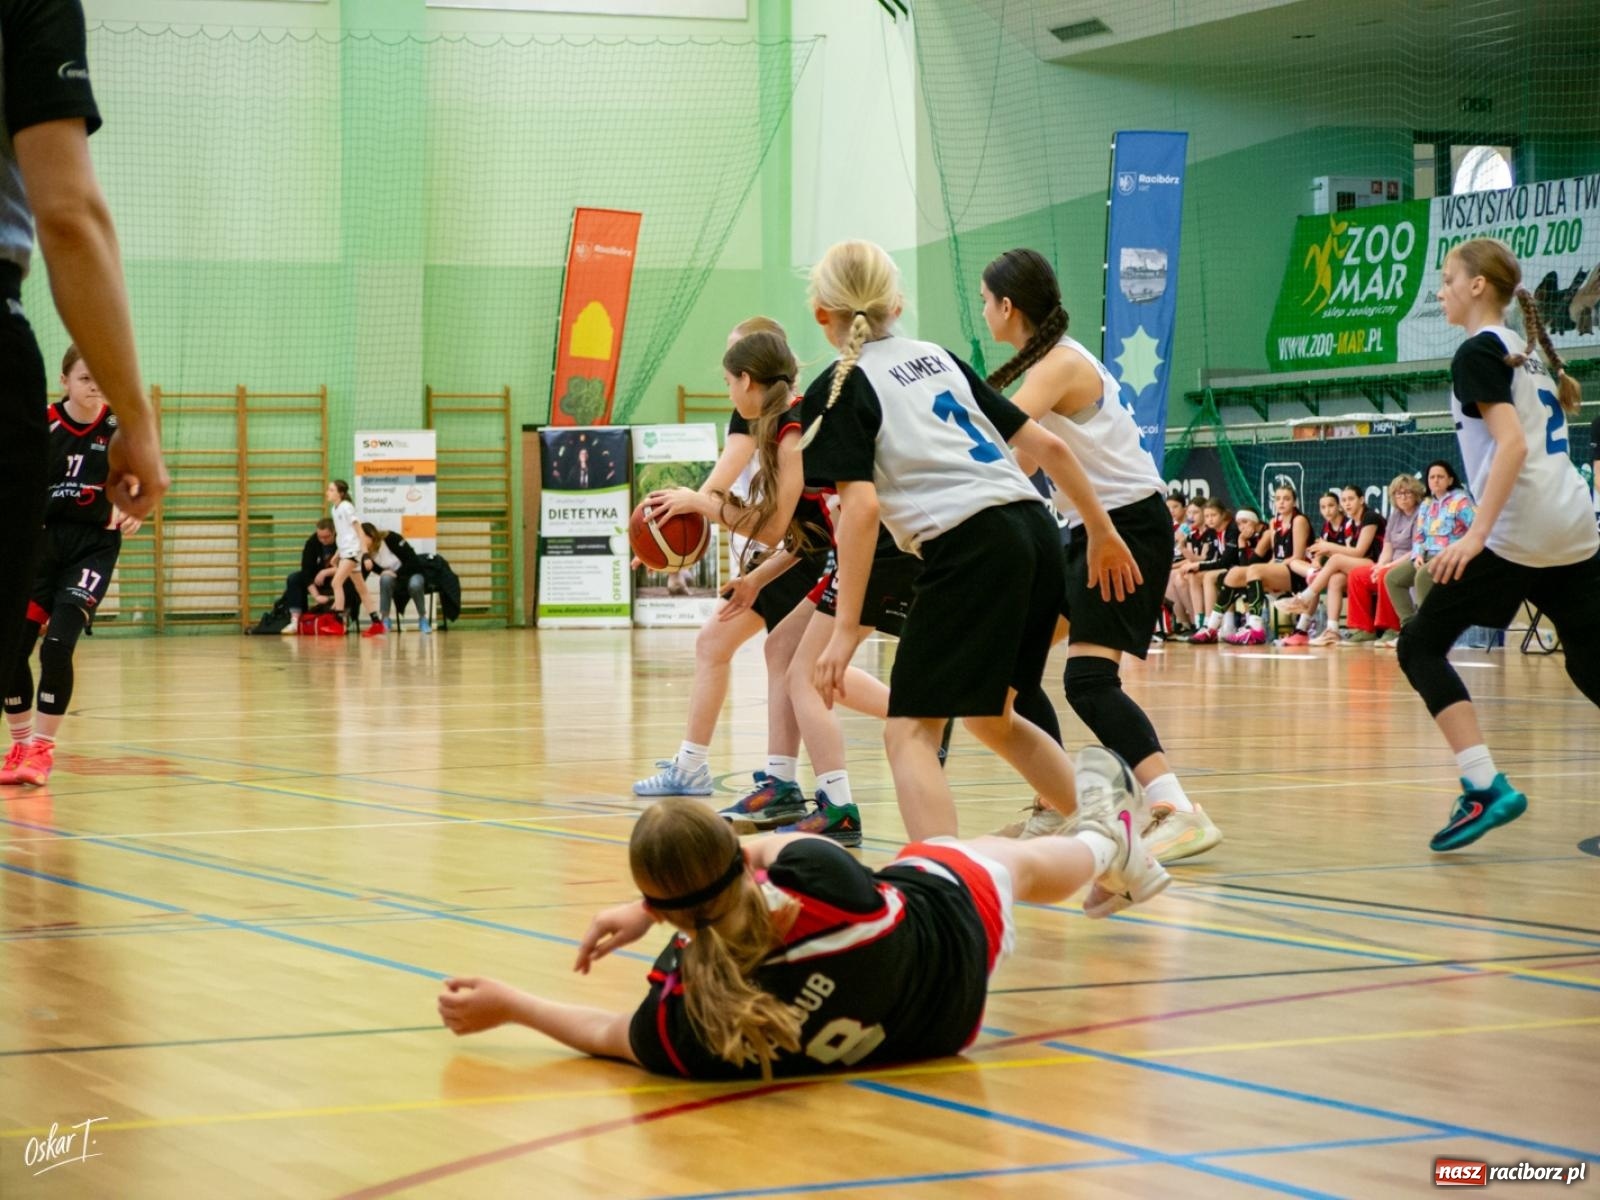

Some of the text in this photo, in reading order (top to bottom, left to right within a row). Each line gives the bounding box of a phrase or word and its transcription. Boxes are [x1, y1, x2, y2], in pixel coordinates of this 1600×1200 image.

[1138, 173, 1180, 185] Racibórz
[1440, 185, 1529, 232] WSZYSTKO
[1534, 181, 1567, 217] DLA
[1343, 221, 1416, 266] ZOO
[1543, 217, 1583, 256] ZOO
[1328, 262, 1408, 305] MAR
[1278, 327, 1384, 361] WWW.ZOO-MAR.PL
[888, 355, 952, 387] KLIMEK
[932, 389, 1005, 464] 1
[1537, 388, 1569, 455] 2
[363, 439, 393, 449] SOWA
[65, 453, 84, 477] 17
[548, 507, 618, 520] DIETETYKA
[77, 568, 102, 592] 17
[612, 560, 622, 601] OFERTA
